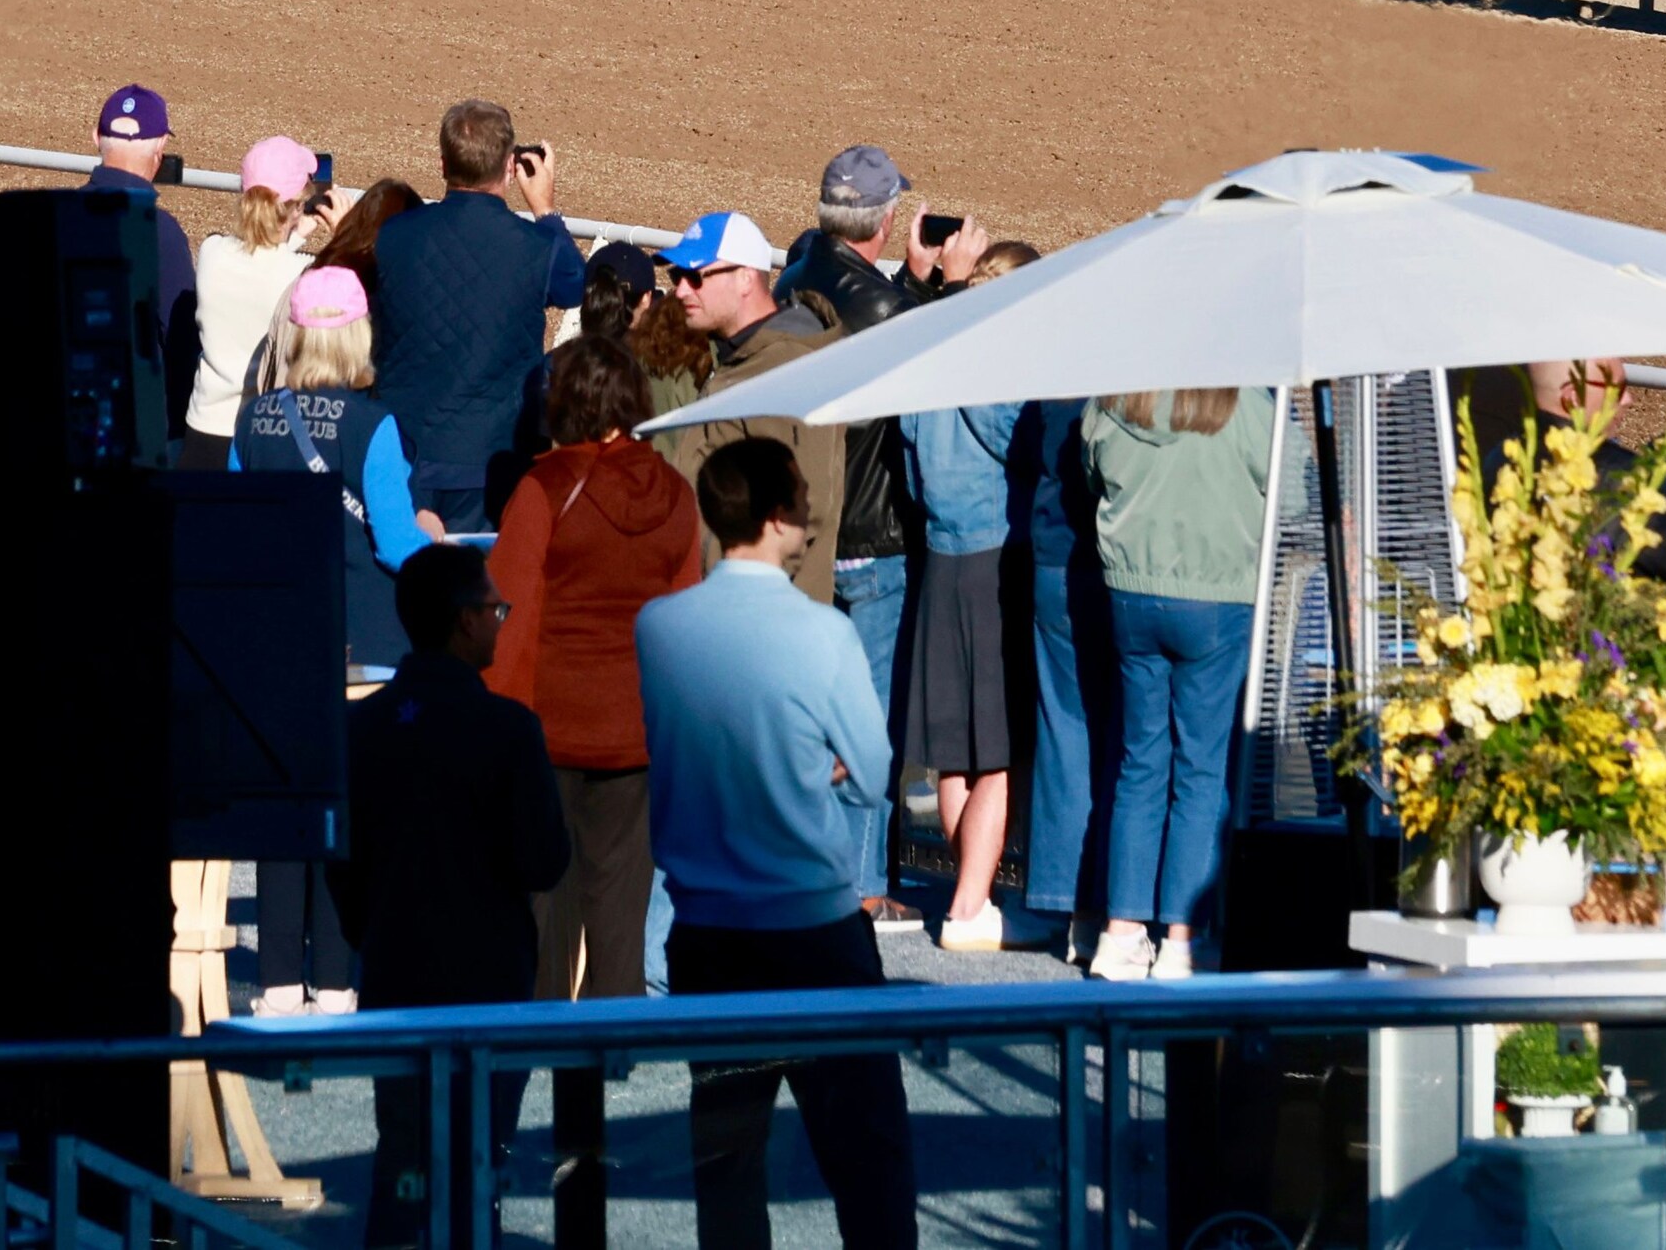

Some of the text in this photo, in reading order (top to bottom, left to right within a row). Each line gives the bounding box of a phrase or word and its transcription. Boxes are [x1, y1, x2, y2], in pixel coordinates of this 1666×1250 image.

[253, 393, 345, 420] GURDS
[250, 417, 338, 440] POLO LUB
